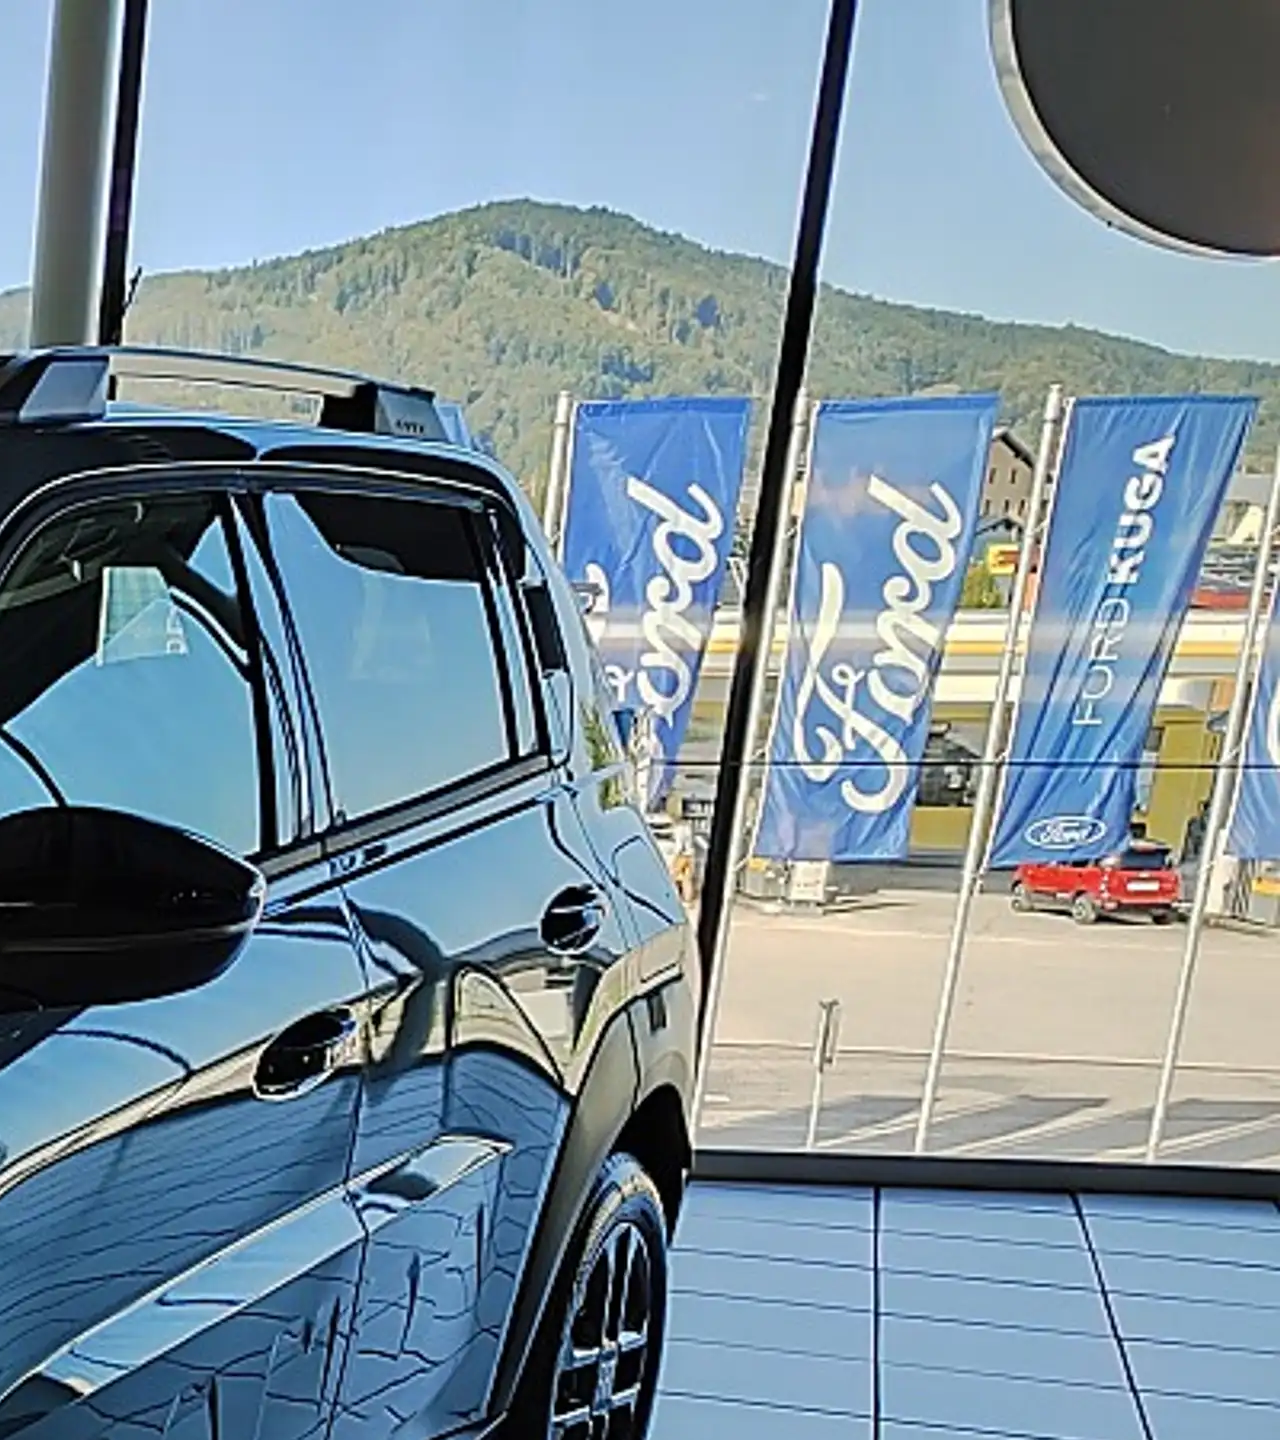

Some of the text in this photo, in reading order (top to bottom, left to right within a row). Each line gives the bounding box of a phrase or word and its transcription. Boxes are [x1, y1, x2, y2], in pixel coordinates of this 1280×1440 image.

[792, 475, 965, 813] Ford
[1072, 434, 1175, 726] FORD KUGA
